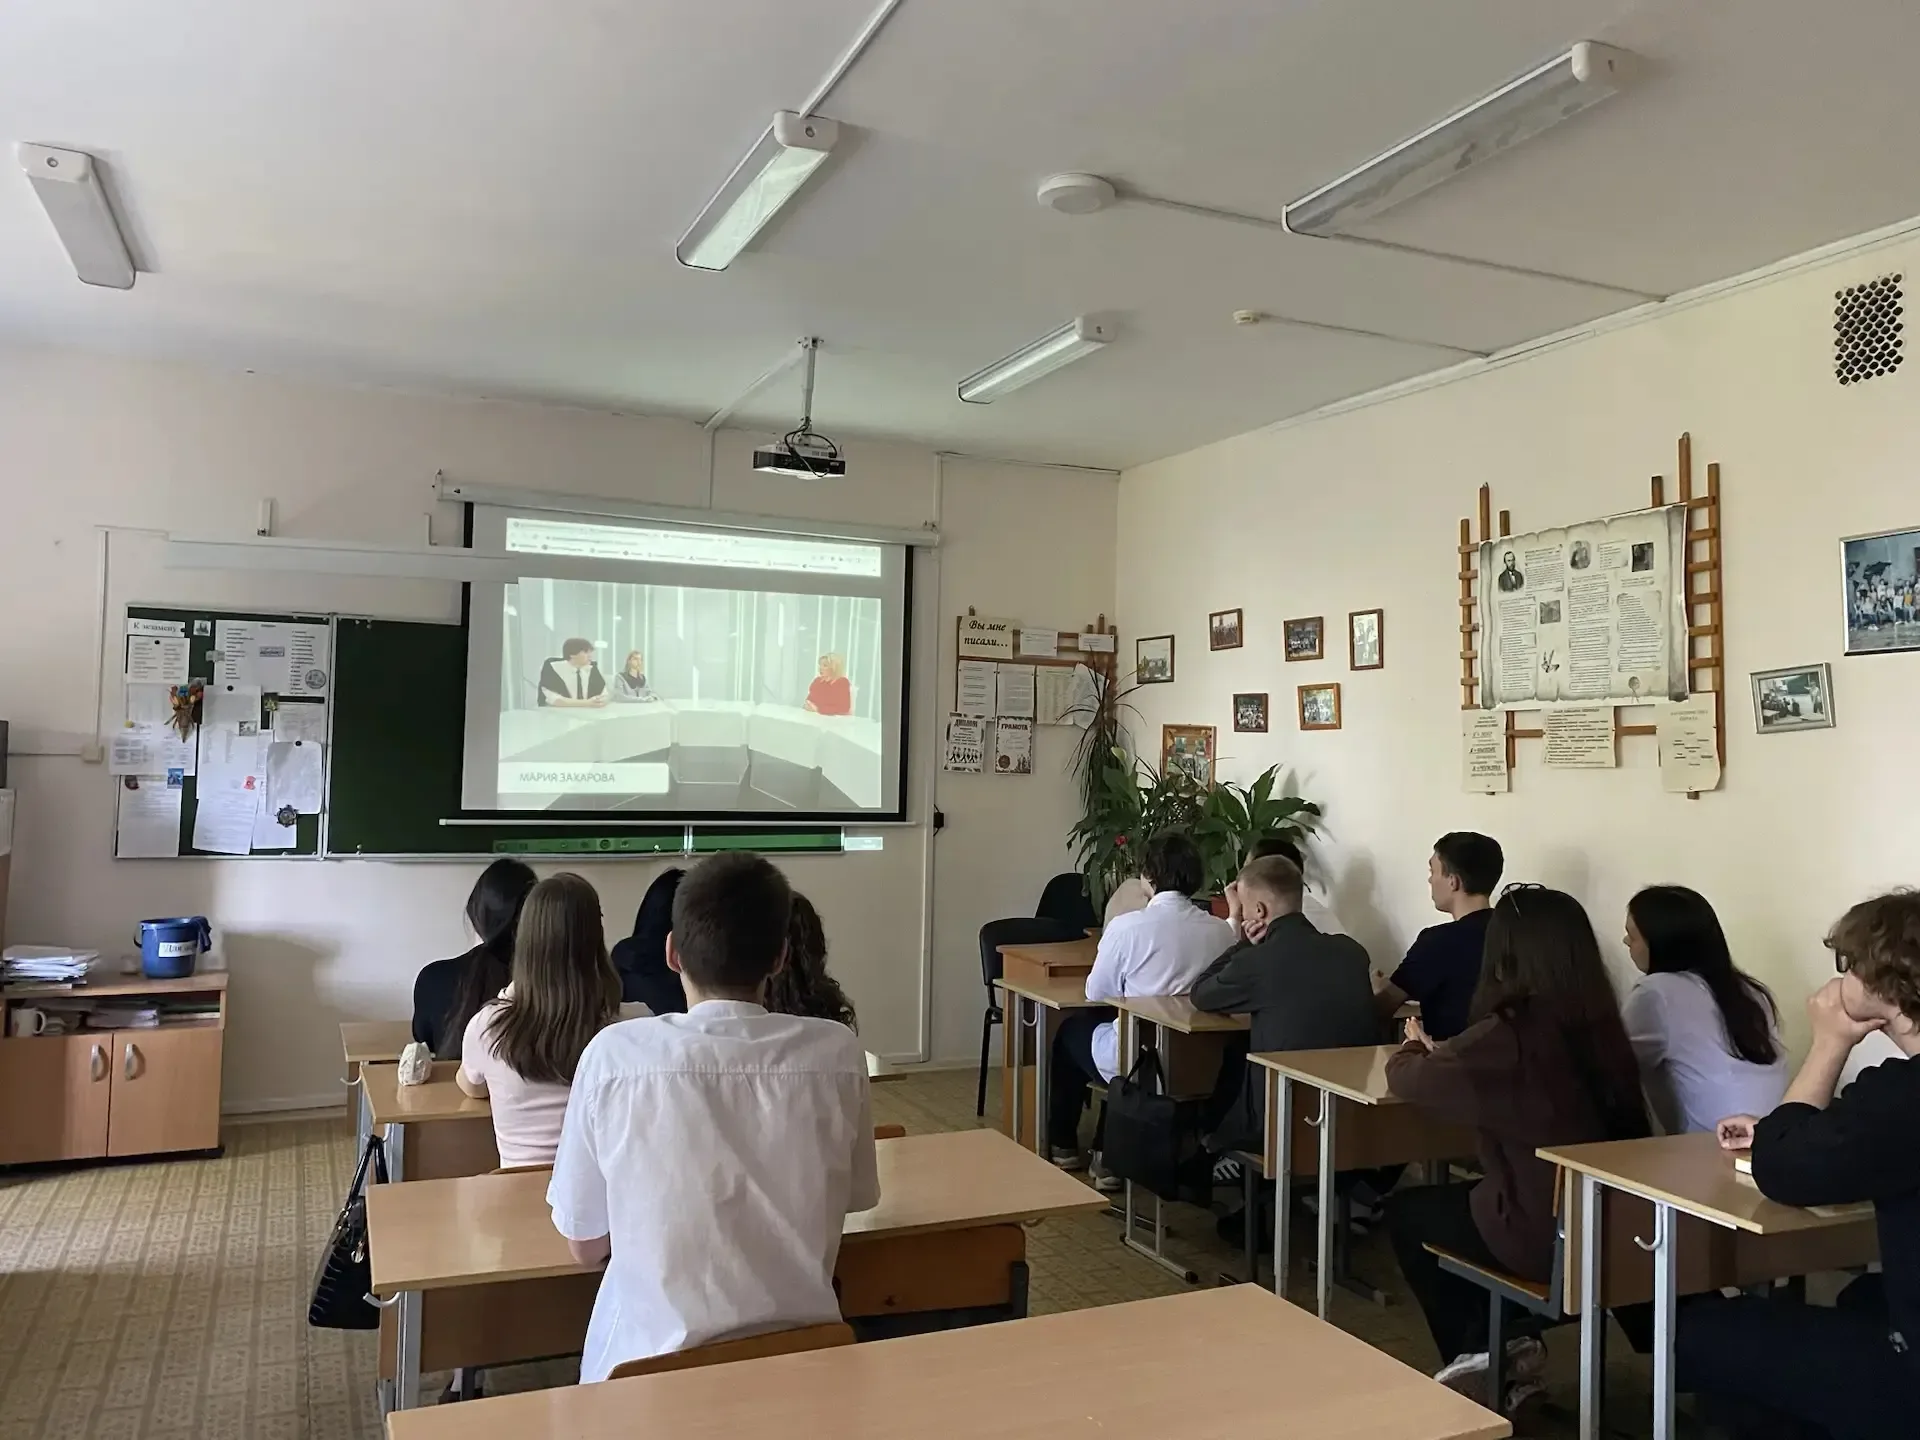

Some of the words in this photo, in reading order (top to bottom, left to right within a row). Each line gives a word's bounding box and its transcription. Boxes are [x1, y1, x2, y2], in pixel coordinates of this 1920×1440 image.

[968, 619, 985, 630] Вы
[986, 623, 1007, 631] мне
[1001, 723, 1028, 731] ГРАМОТА
[519, 771, 559, 783] МАРИЯ
[560, 772, 616, 784] ЗАХАРОВА
